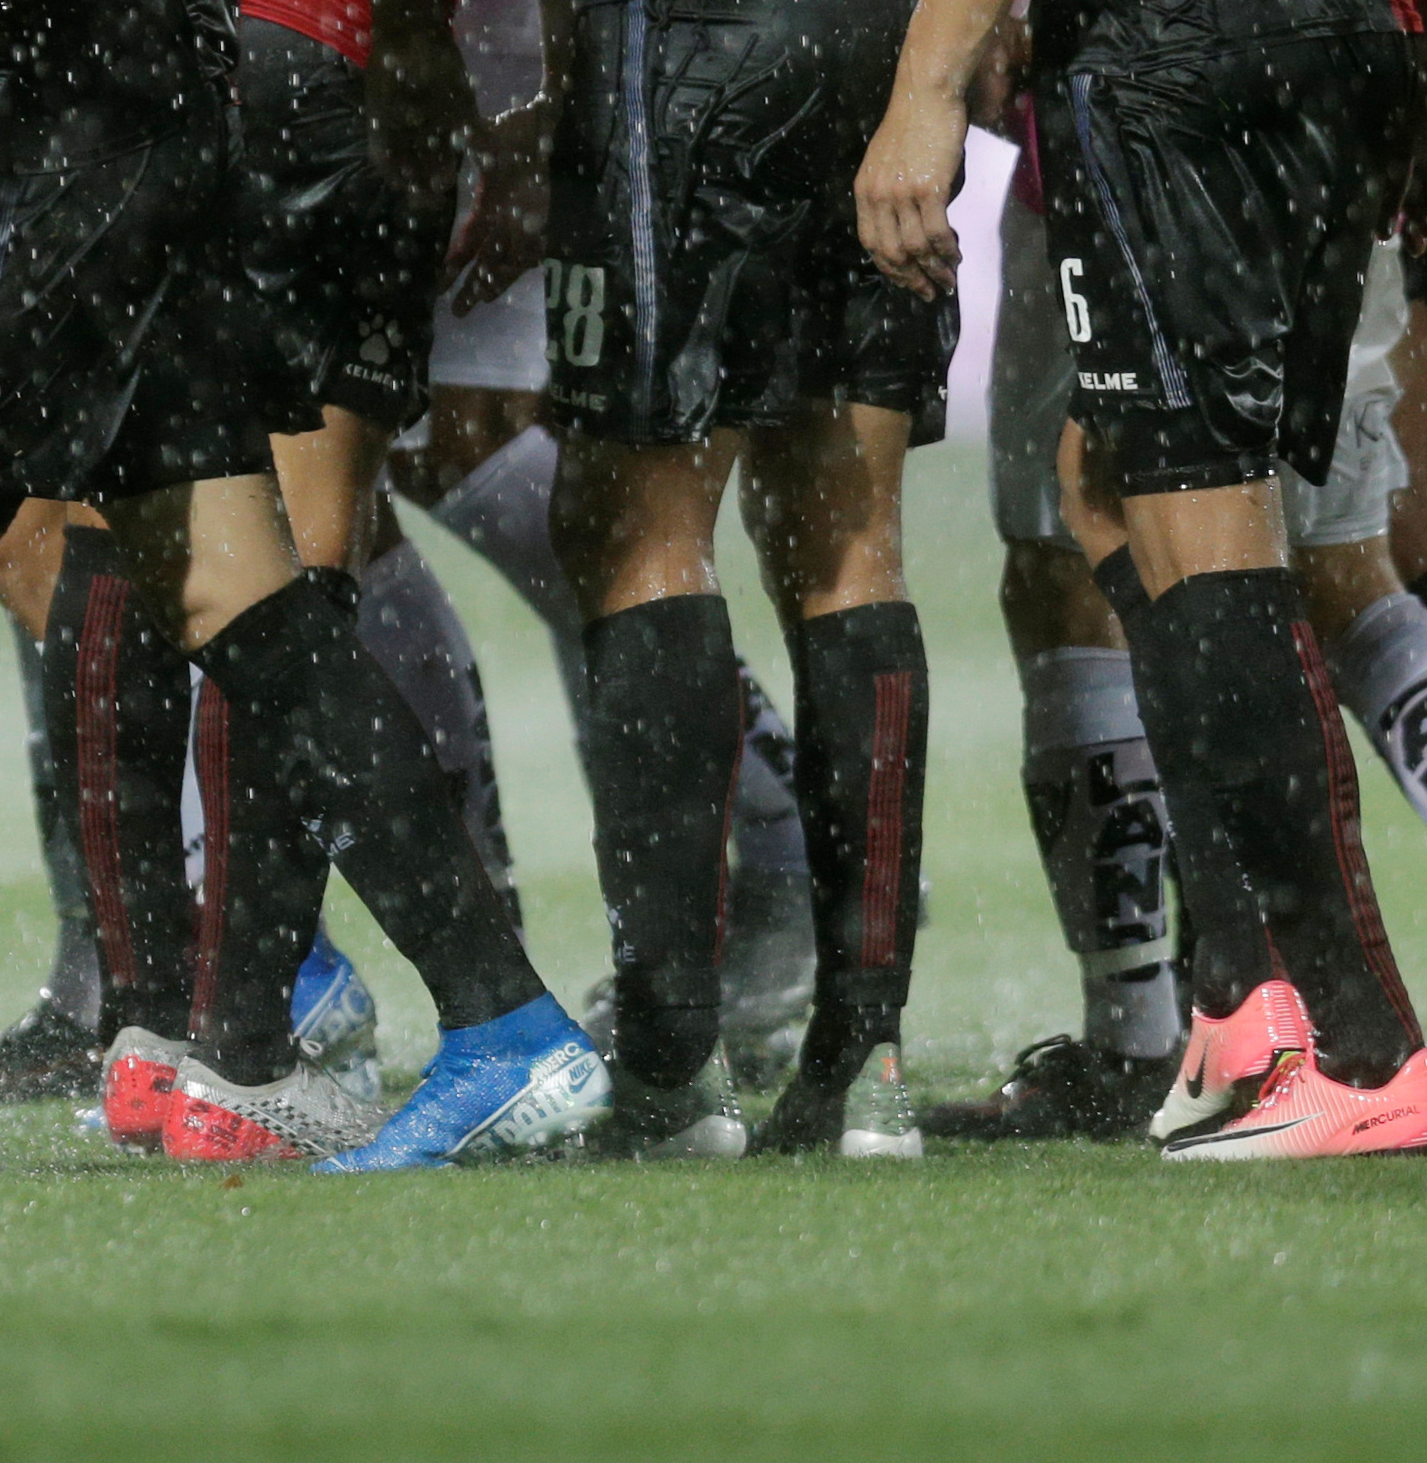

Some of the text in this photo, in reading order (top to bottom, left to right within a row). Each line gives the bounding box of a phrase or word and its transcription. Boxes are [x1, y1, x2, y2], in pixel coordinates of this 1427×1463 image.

[1060, 258, 1092, 342] 6
[567, 1057, 595, 1083] NIKE
[1352, 1104, 1421, 1136] MERCURIAL
